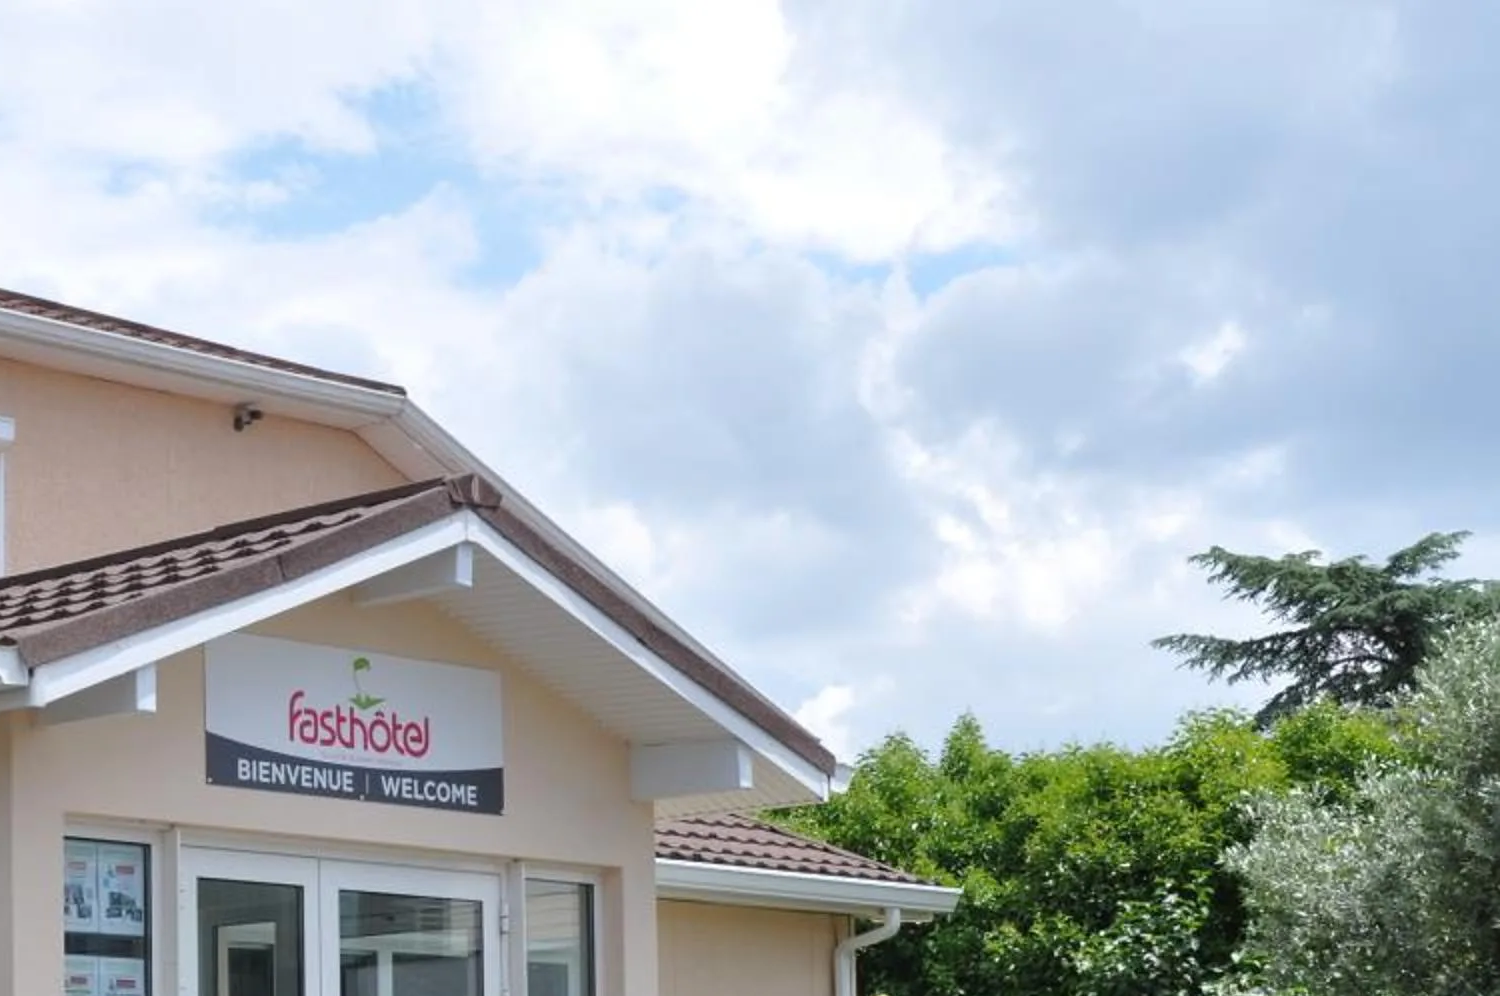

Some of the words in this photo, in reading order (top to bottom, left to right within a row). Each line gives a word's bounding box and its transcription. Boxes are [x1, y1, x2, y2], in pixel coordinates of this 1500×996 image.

[289, 690, 430, 758] fasthôtel
[237, 758, 354, 792] BIENVENUE
[381, 774, 478, 806] WELCOME
